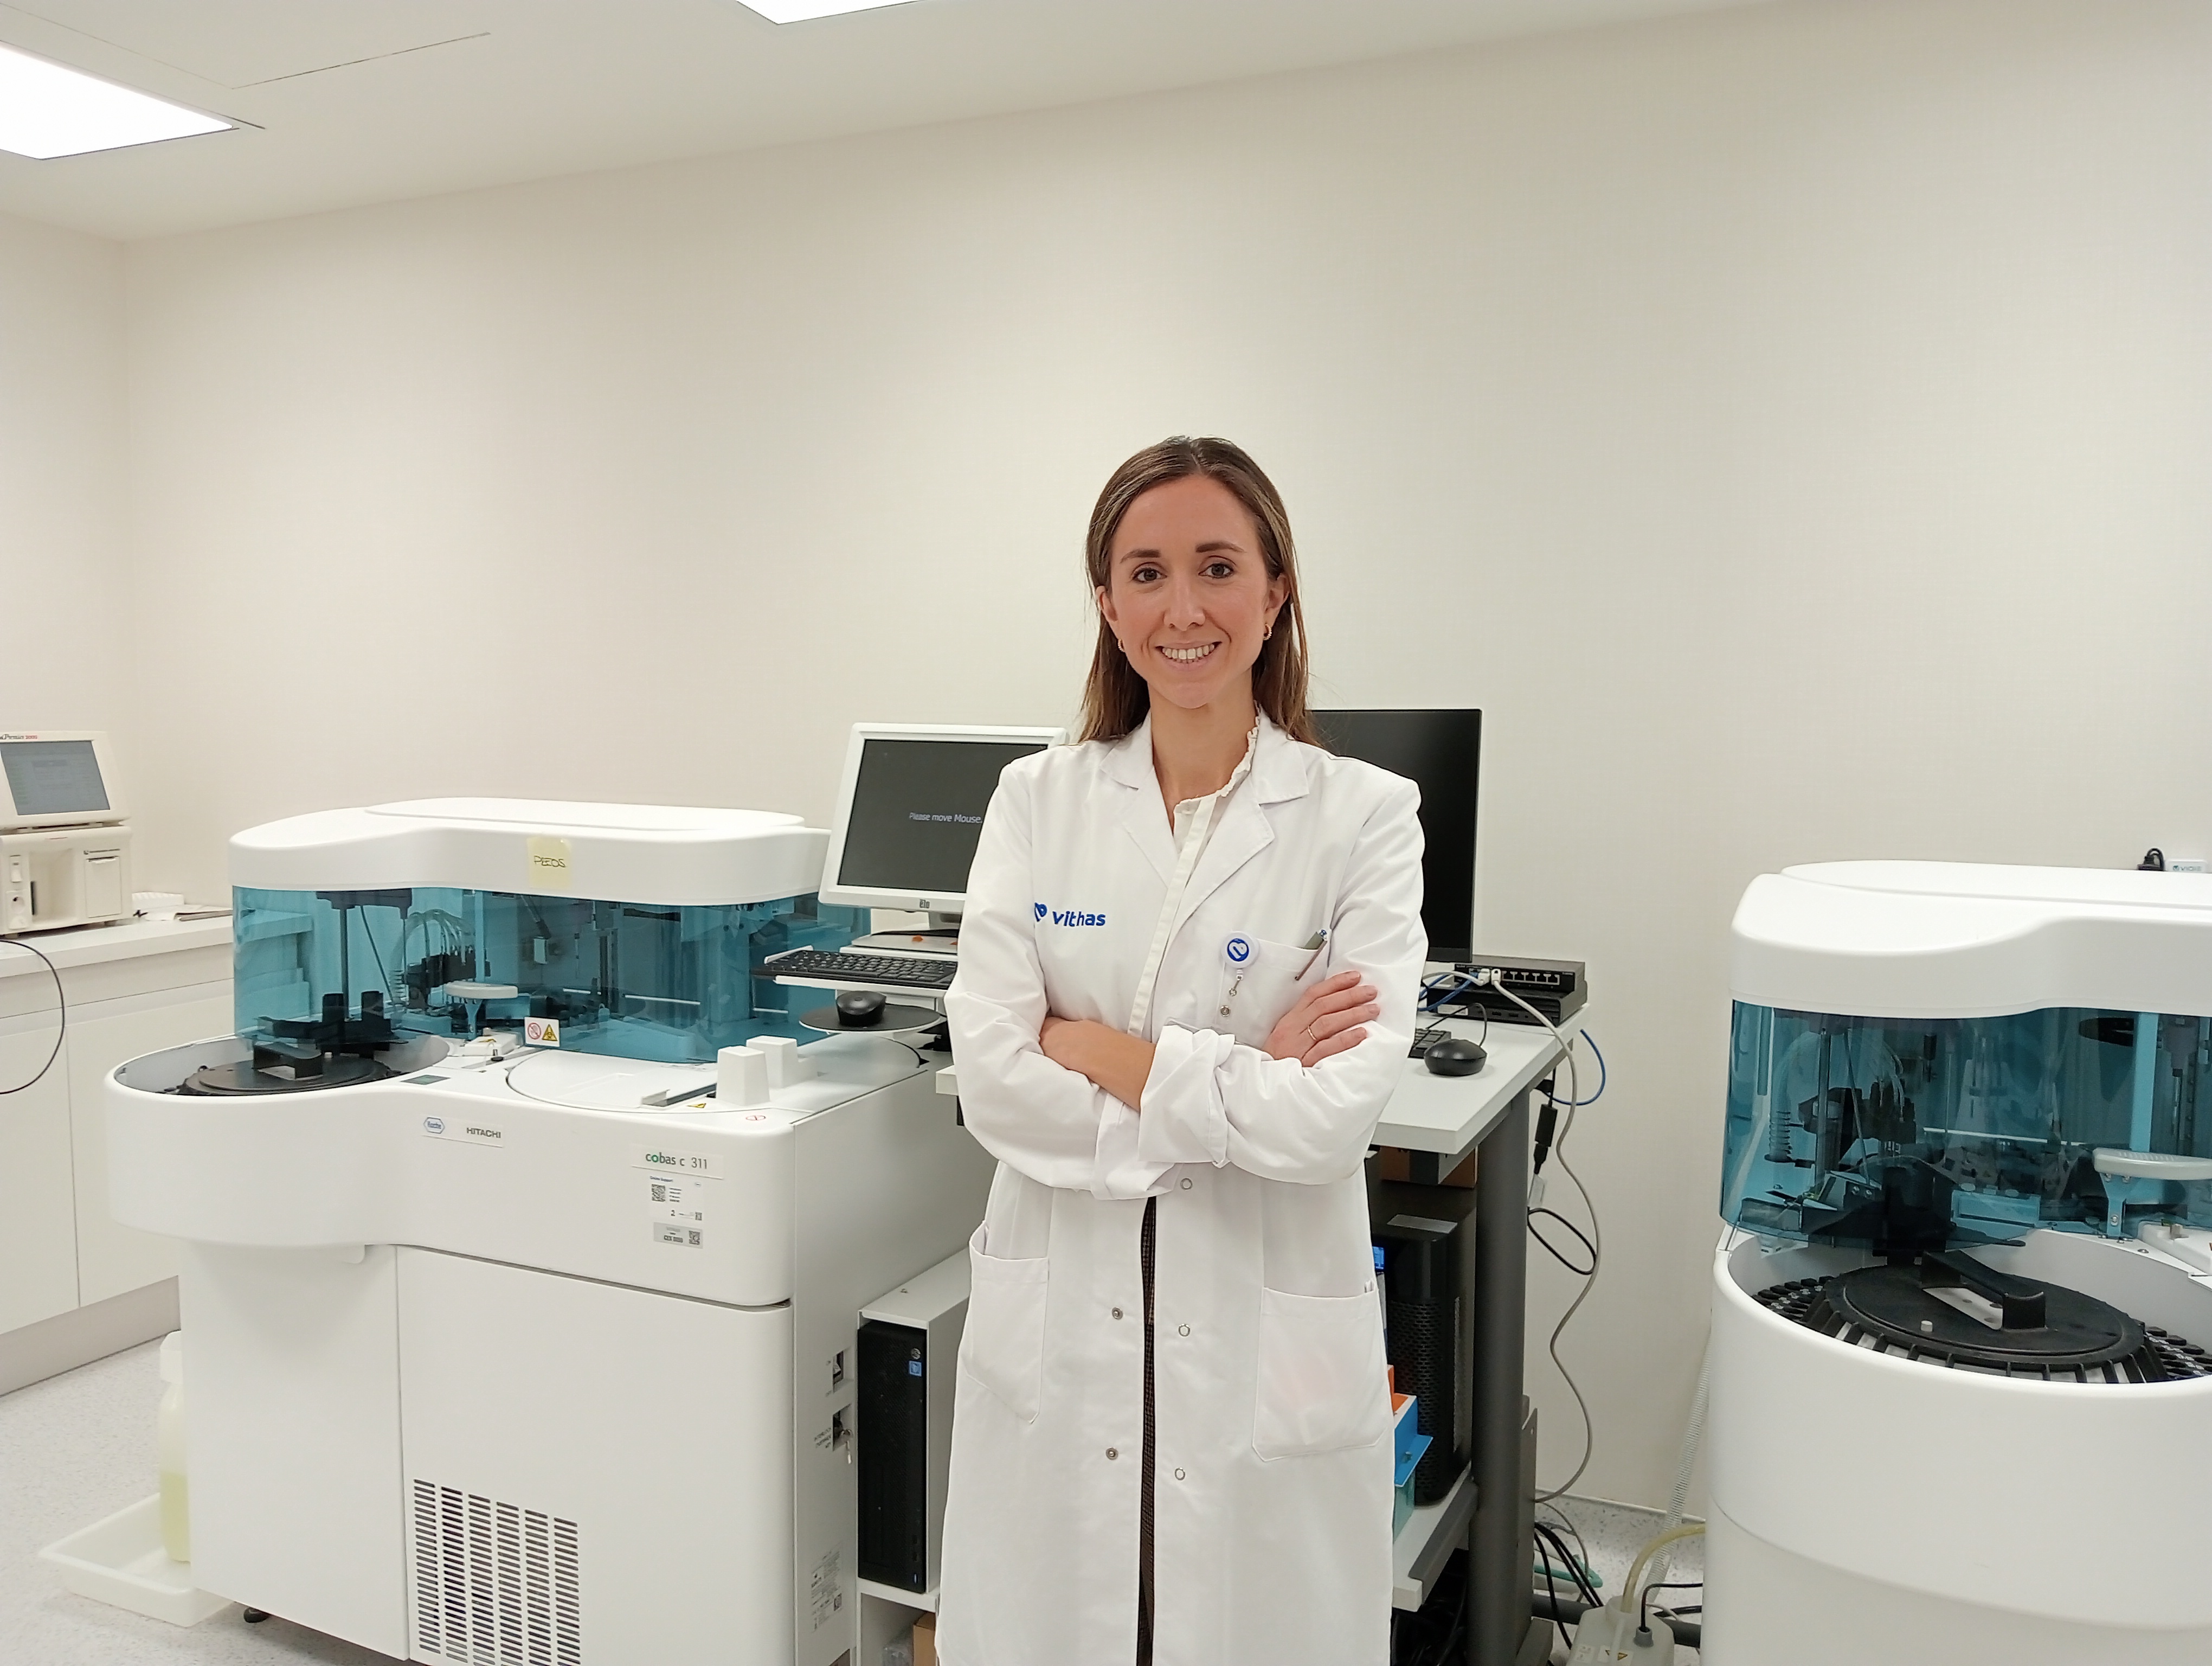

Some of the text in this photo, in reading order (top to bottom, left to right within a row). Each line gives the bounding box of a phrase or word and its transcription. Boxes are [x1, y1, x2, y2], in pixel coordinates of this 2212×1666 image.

[909, 812, 930, 821] Please
[1052, 911, 1105, 927] vithas
[466, 1127, 501, 1138] HITACHI
[646, 1152, 707, 1169] cobas c 311
